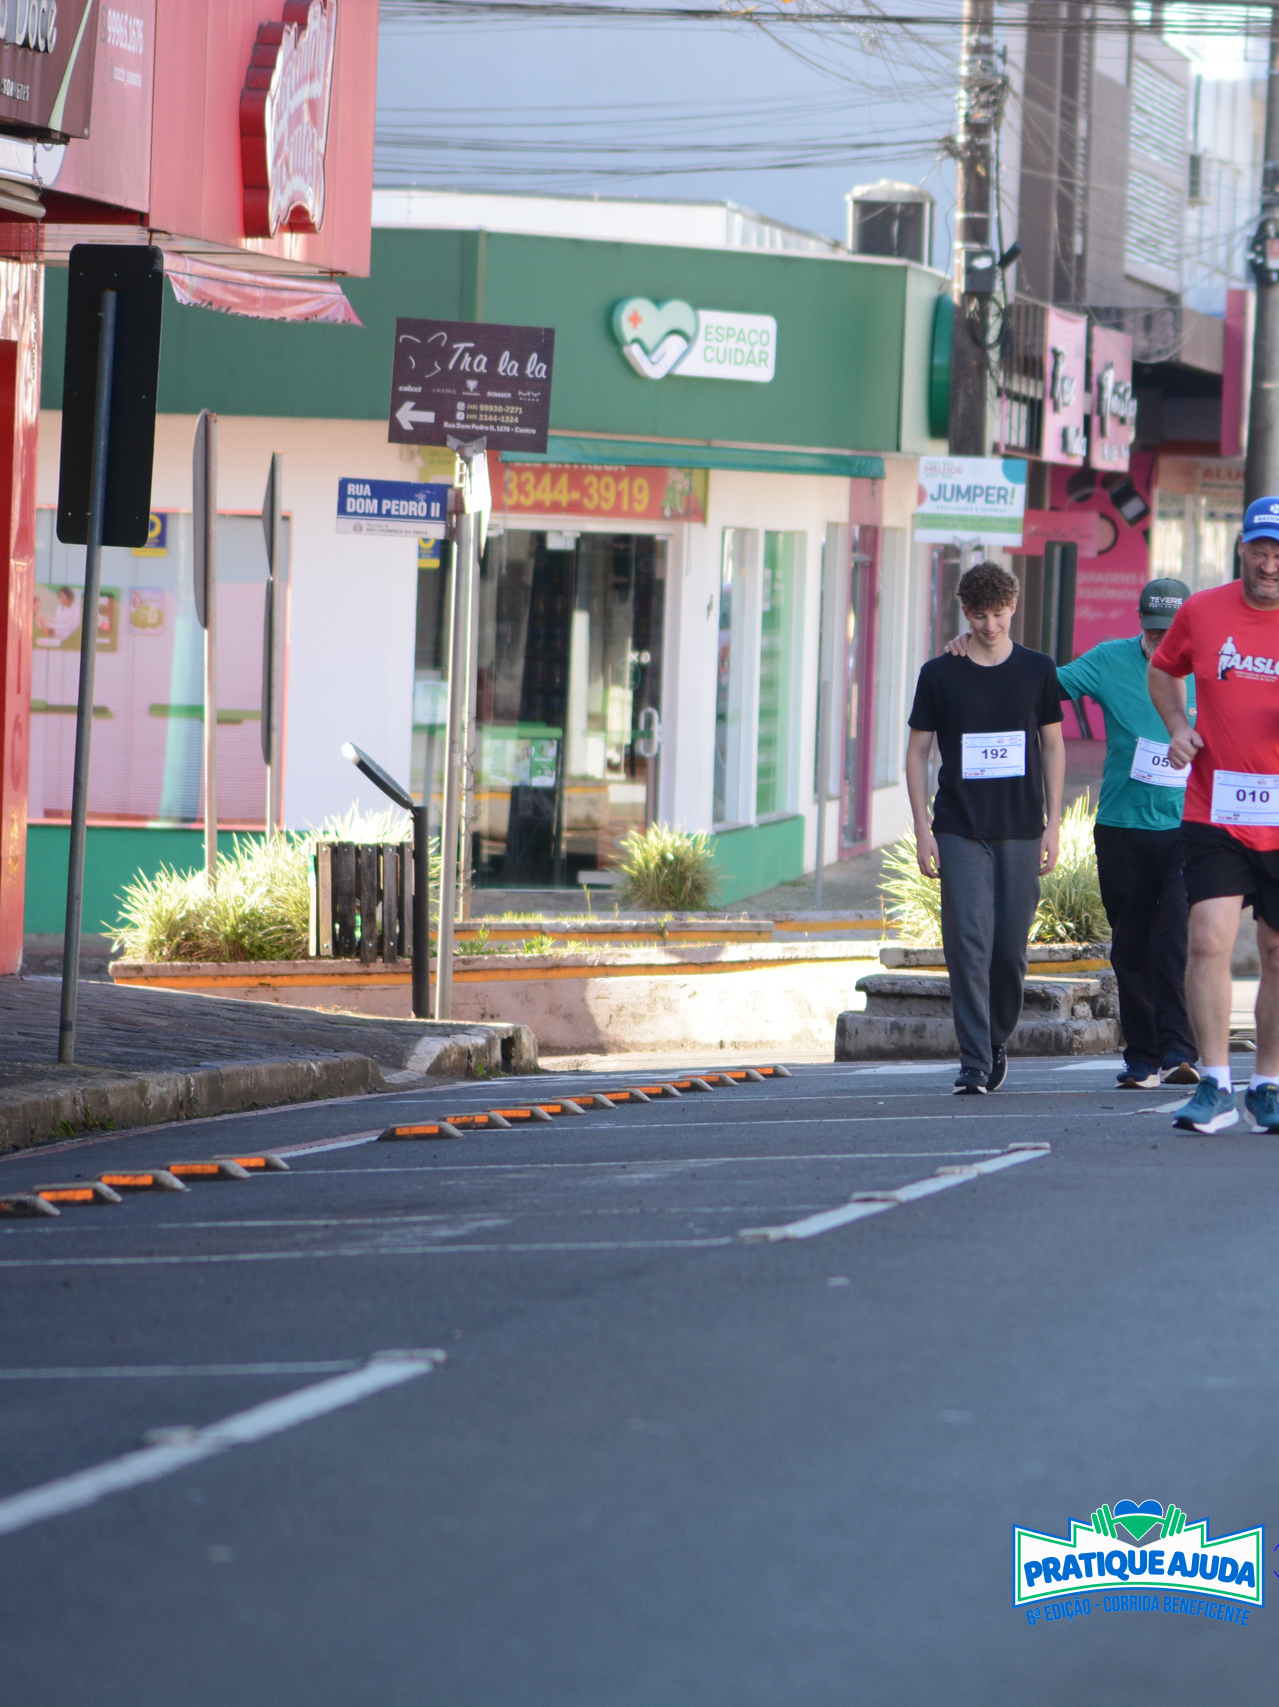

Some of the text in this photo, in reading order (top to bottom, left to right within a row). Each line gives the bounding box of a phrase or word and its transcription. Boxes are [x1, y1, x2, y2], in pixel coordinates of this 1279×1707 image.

[704, 325, 771, 349] ESPAÇO
[449, 343, 547, 379] Tra la la
[703, 345, 769, 368] CUIDAR
[443, 421, 456, 429] Rua
[925, 465, 963, 475] MELHOR
[1203, 467, 1245, 481] ALU
[347, 483, 371, 497] RUA
[503, 471, 649, 513] 3344-3919
[930, 483, 1016, 505] JUMPER!
[346, 497, 440, 518] DOM PEDRO II
[1077, 587, 1139, 600] ESSÓRIOS
[1150, 596, 1183, 604] TEVERE
[981, 747, 1008, 760] 192
[1151, 755, 1175, 768] 05
[1236, 789, 1270, 803] 010
